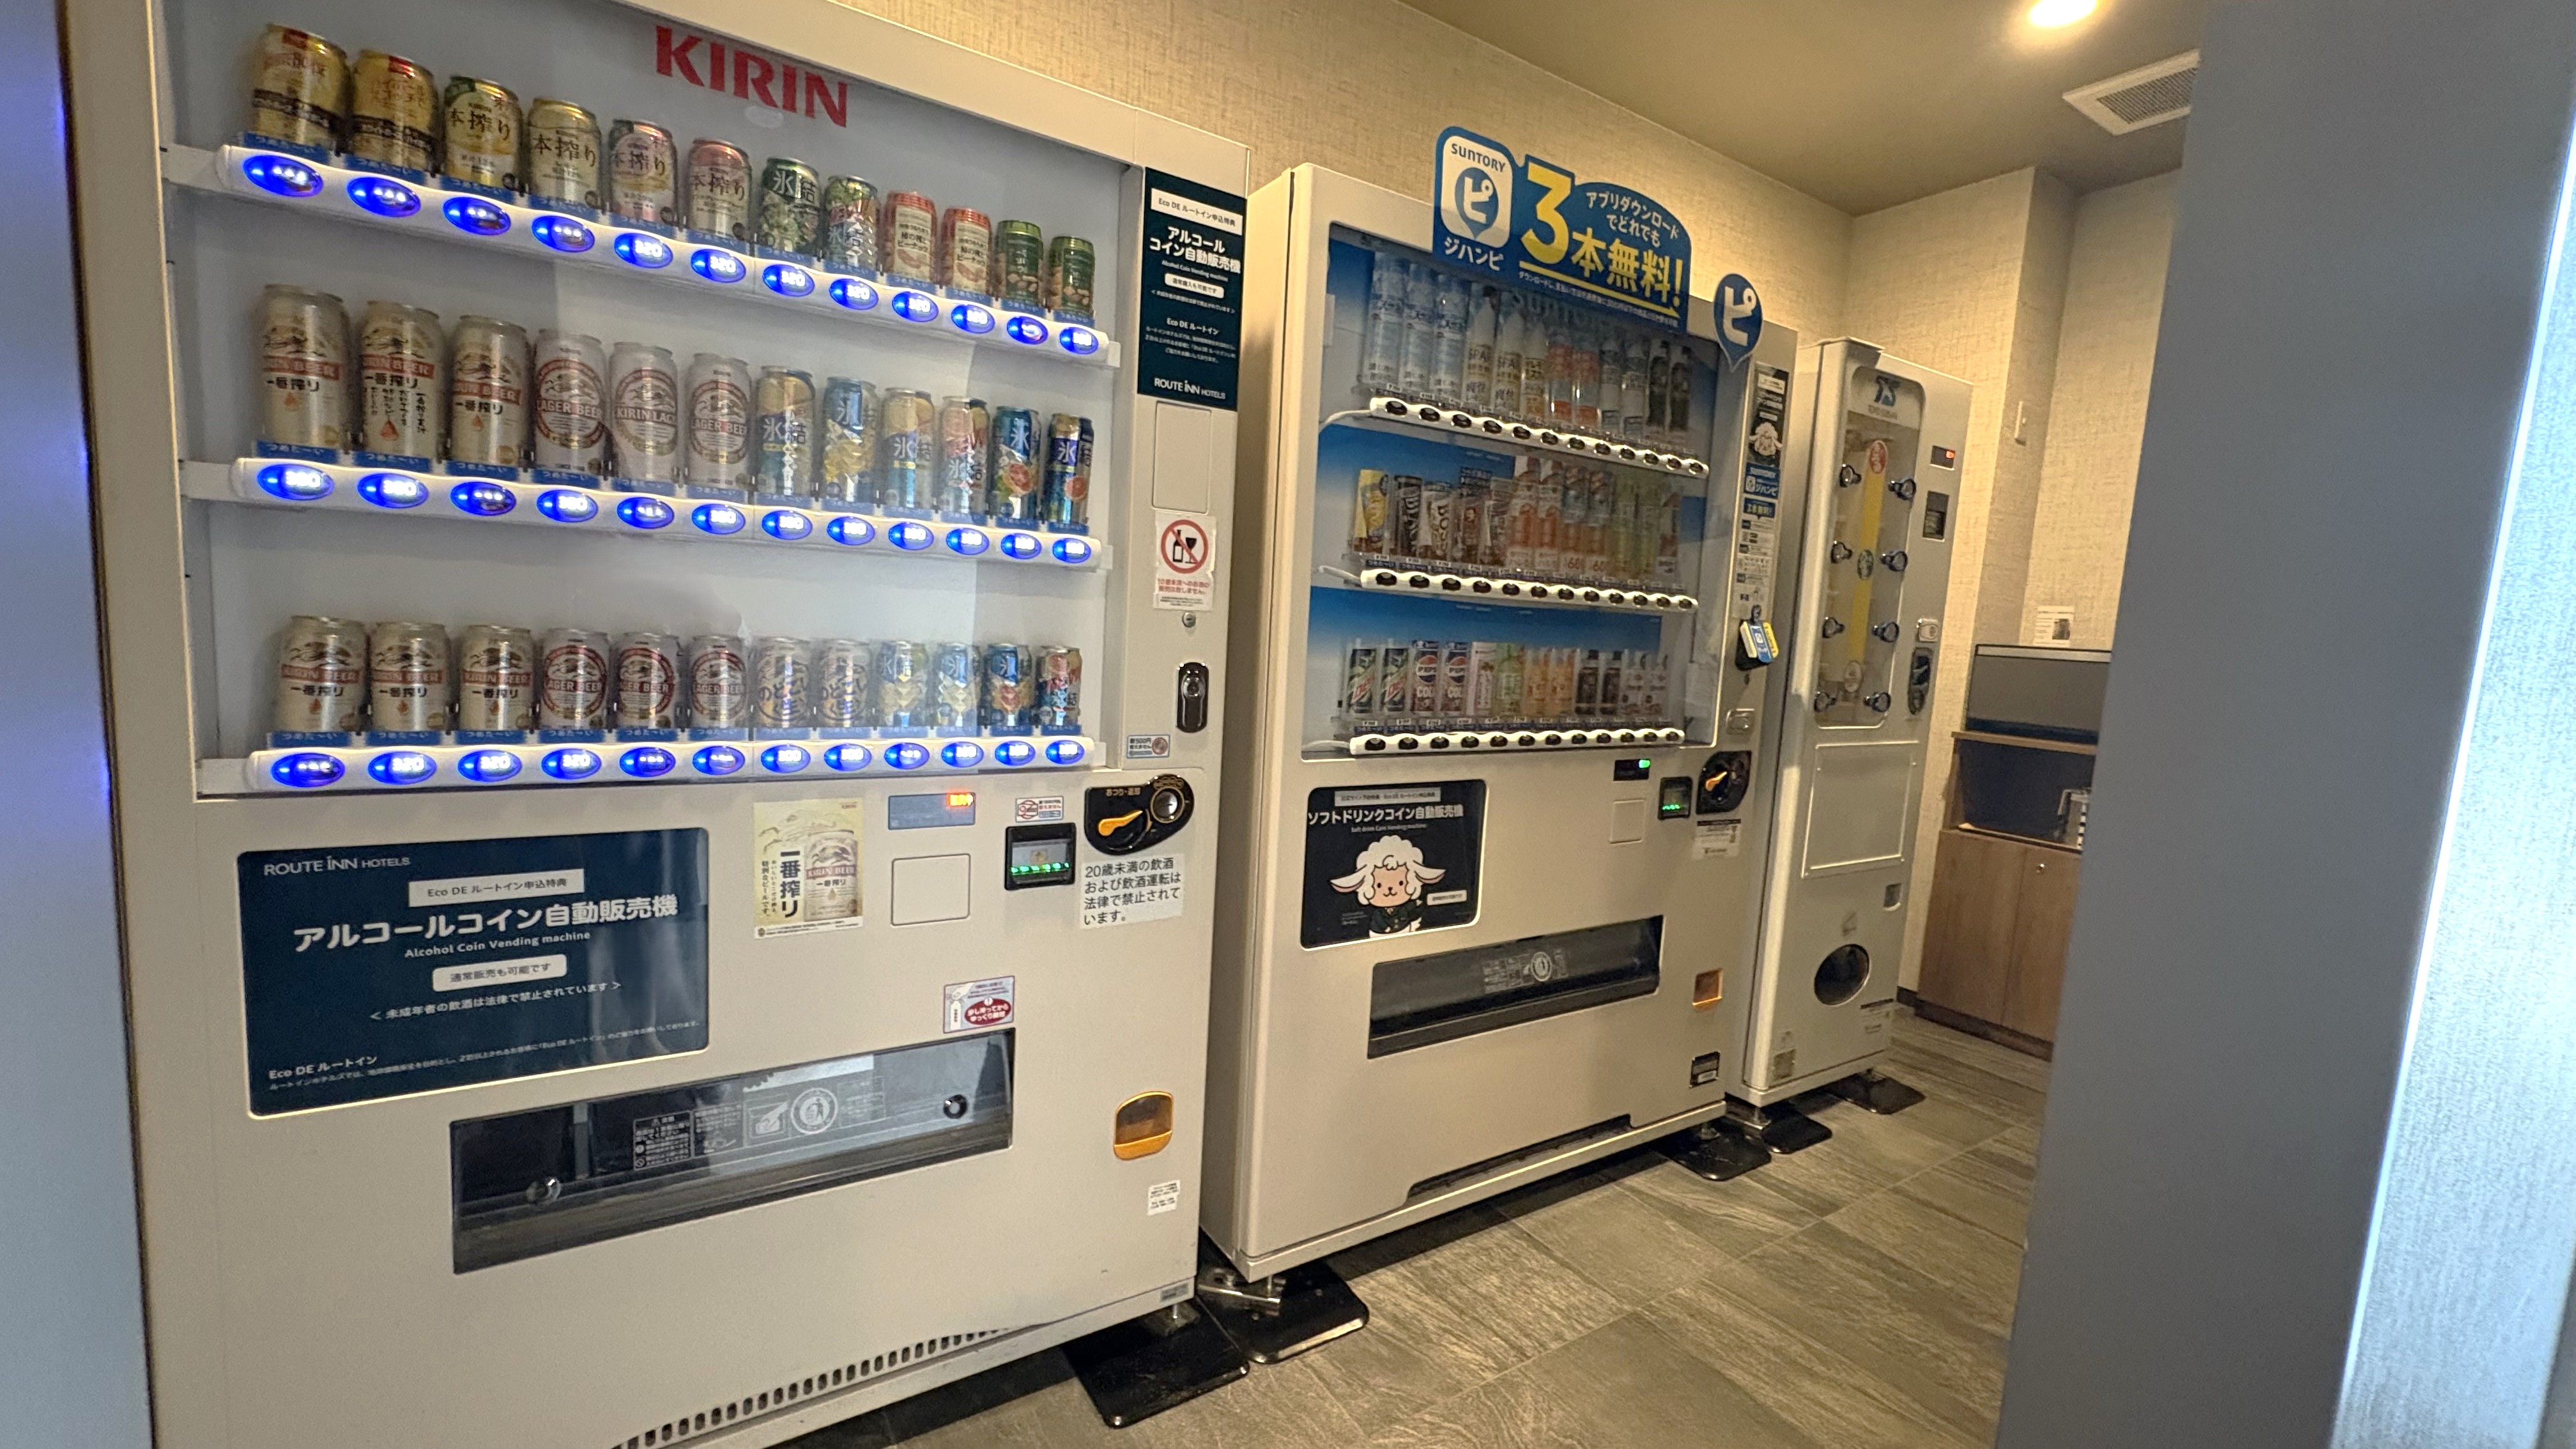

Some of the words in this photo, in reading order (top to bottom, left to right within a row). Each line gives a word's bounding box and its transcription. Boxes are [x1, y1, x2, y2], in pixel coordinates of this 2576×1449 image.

[656, 25, 848, 128] KIRIN
[533, 134, 595, 167] 本搾り
[1451, 143, 1506, 172] SUNTORY
[1158, 197, 1170, 207] Eco
[1172, 201, 1181, 210] DE
[1586, 191, 1681, 240] アプリダウンロード
[1167, 226, 1225, 253] アルコール
[1607, 214, 1661, 248] でどれでも
[1149, 237, 1241, 274] コイン自動販売機
[1444, 236, 1504, 272] ジハンピ
[1167, 318, 1179, 326] Eco
[1179, 320, 1189, 329] DE
[266, 376, 319, 392] 一番搾り
[364, 373, 418, 389] 一番搾り
[1154, 378, 1183, 392] ROUTE
[1201, 388, 1226, 400] HOTELS
[454, 401, 503, 416] 一番搾り
[289, 683, 344, 697] 一番搾り
[379, 686, 427, 698] 一番搾り
[471, 687, 519, 699] 一番搾り
[643, 682, 669, 693] BEER
[1308, 804, 1464, 825] ソフトドリンクコイン自動販売機
[263, 859, 324, 876] ROUTE
[361, 857, 411, 869] HOTELS
[1085, 857, 1174, 878] 20歳未満の飲酒
[427, 888, 448, 897] Eco
[452, 886, 468, 895] DE
[471, 878, 569, 894] ルートイン申込特典
[780, 850, 801, 918] 一番搾り
[816, 878, 847, 887] 一番搾り
[1085, 873, 1181, 894] および飲酒運転は
[1084, 887, 1181, 910] 法律で禁止されて
[293, 893, 678, 952] アルコールコイン自動販売機
[1084, 910, 1126, 925] います。
[404, 942, 454, 958] Alcohol
[457, 940, 486, 953] Coin
[489, 935, 540, 948] Vending
[542, 931, 591, 944] machine
[450, 963, 551, 983] 通常販売も可能です
[268, 1069, 293, 1080] Eco
[296, 1065, 314, 1076] DE
[317, 1055, 378, 1073] ルートイン
